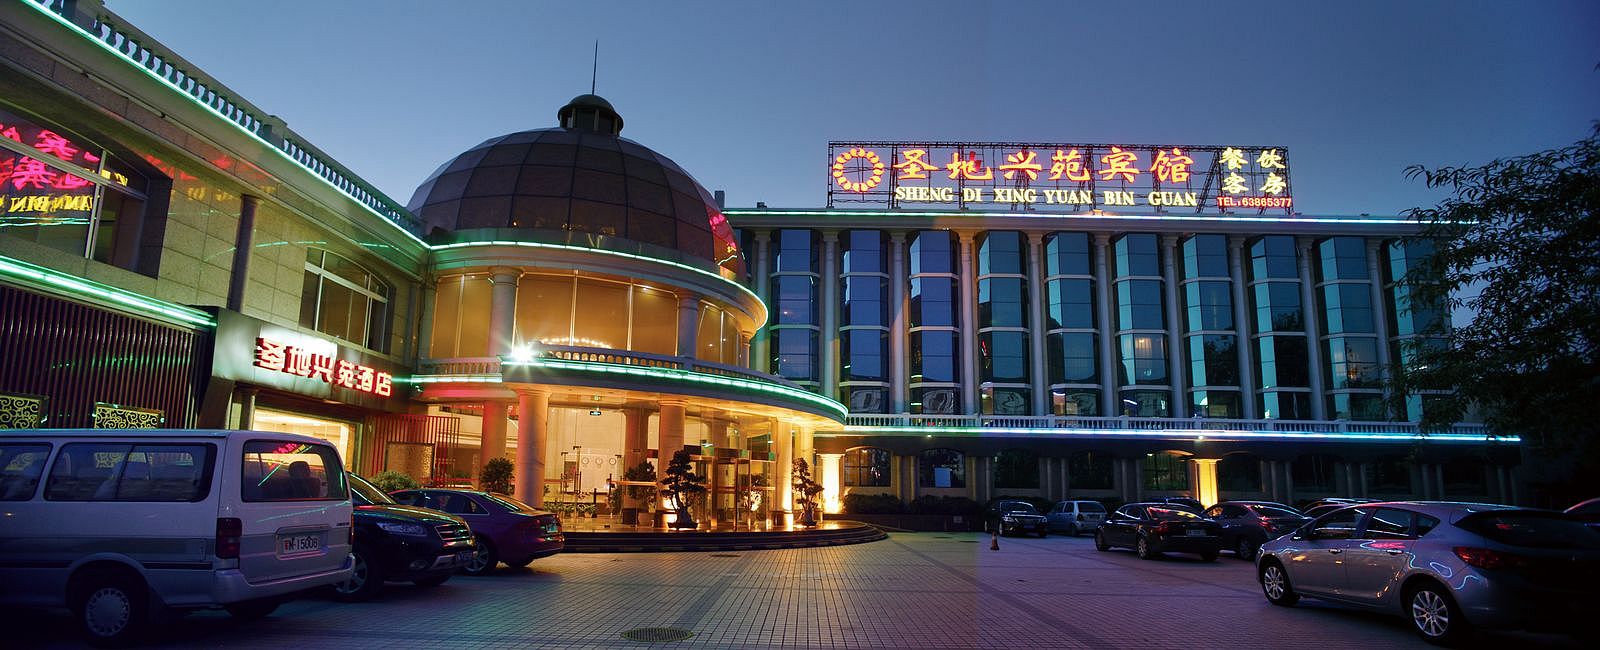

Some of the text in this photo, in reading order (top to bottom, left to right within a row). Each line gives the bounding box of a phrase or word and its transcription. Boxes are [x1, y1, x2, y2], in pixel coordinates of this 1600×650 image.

[893, 147, 1194, 184] 圣地兴苑宾馆
[1219, 147, 1286, 170] 餐饮
[1221, 172, 1287, 195] 客房
[895, 186, 1198, 207] SHENG DI XING YUAN BIN GUAN
[253, 337, 393, 397] 圣地兴苑酒店
